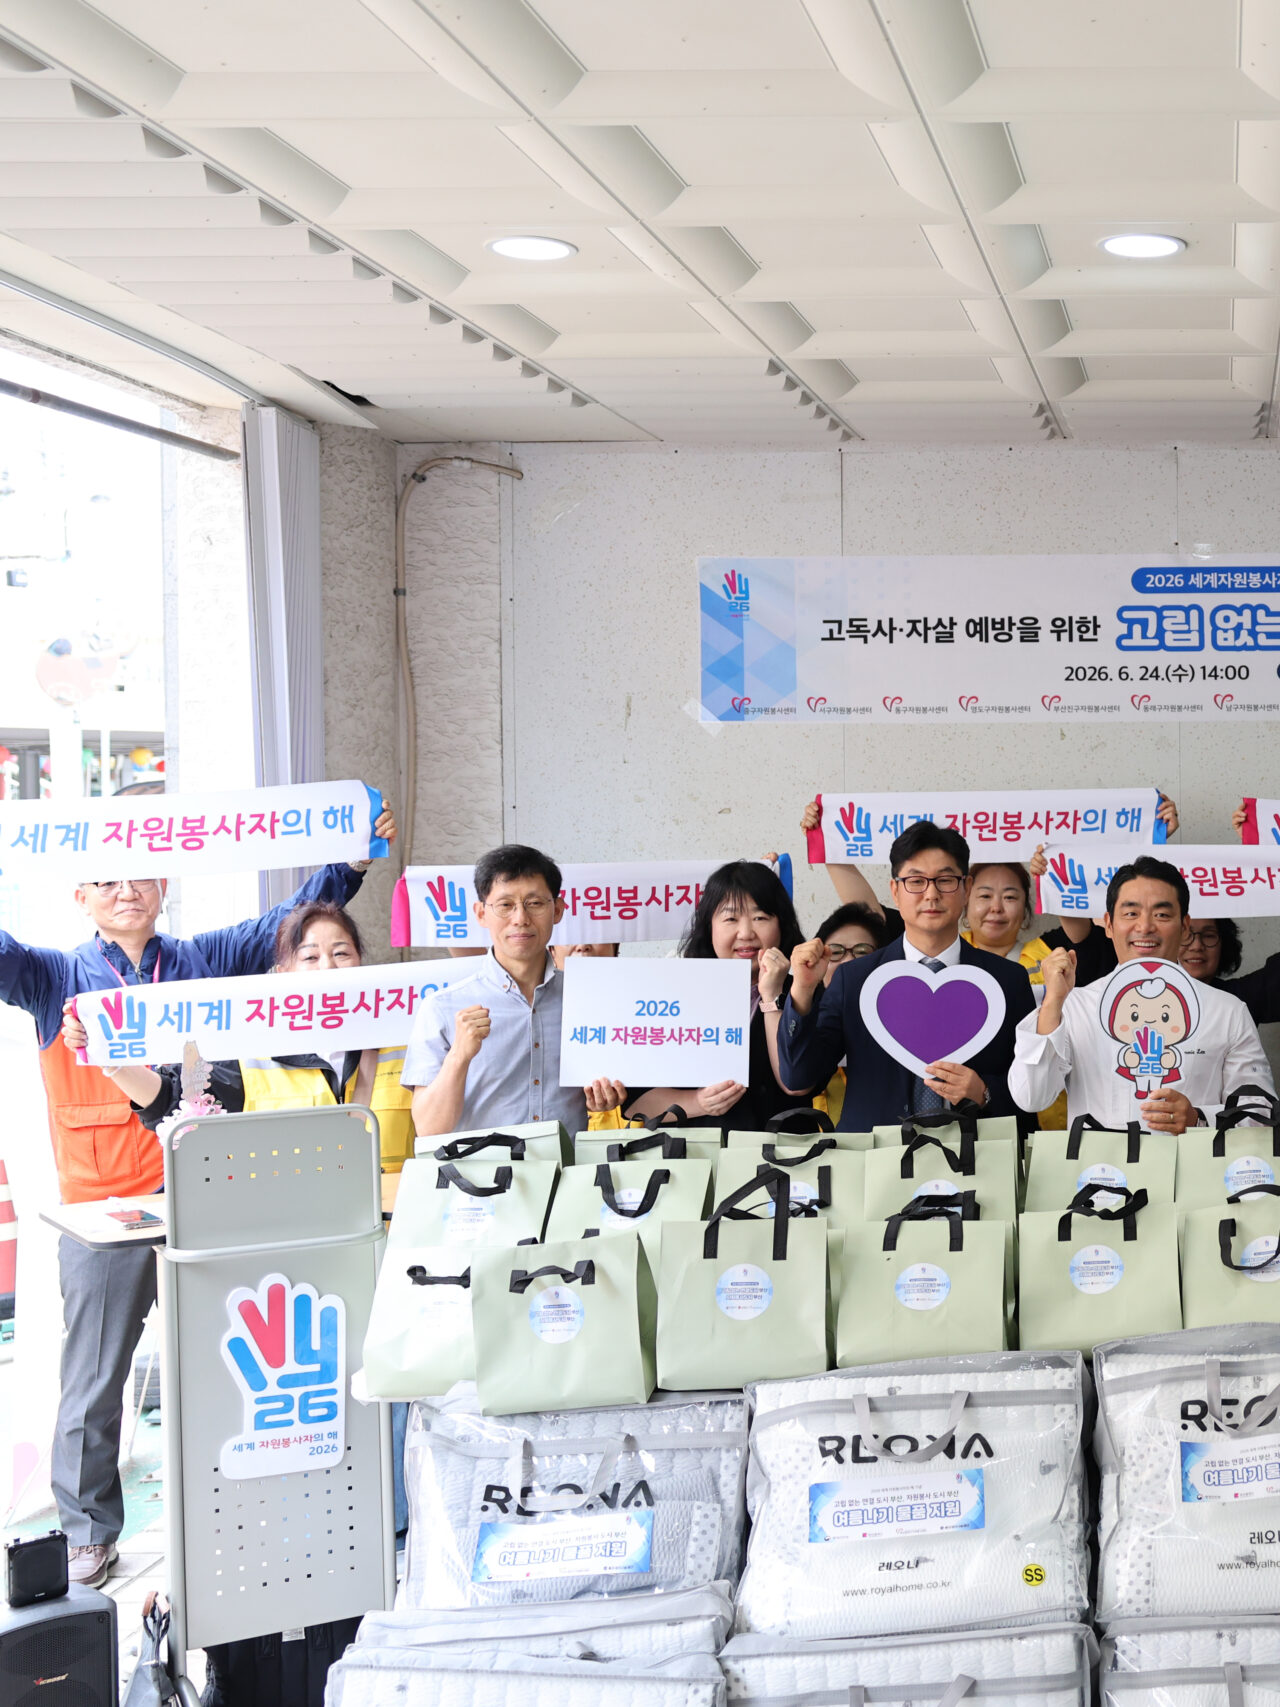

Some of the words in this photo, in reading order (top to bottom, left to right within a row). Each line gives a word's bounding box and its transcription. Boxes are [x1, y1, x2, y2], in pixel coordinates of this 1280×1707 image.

[1145, 574, 1184, 588] 2026
[820, 616, 957, 644] 고독사·자살
[965, 616, 1042, 643] 예방을
[1050, 615, 1101, 643] 위한
[1116, 604, 1205, 652] 고립
[1064, 666, 1113, 682] 2026.
[1118, 666, 1134, 682] 6.
[1138, 663, 1195, 683] 24.(수)
[1200, 664, 1250, 681] 14:00
[10, 821, 90, 854] 세계
[102, 808, 312, 853] 자원봉사자의
[322, 804, 355, 834] 해
[1115, 806, 1143, 834] 해
[846, 843, 874, 858] 26
[1061, 894, 1090, 910] 26
[436, 922, 468, 938] 26
[156, 998, 232, 1034] 세계
[634, 1000, 680, 1016] 2026
[570, 1026, 606, 1045] 세계
[611, 1026, 720, 1046] 자원봉사자의
[724, 1027, 743, 1046] 해
[108, 1042, 147, 1059] 26
[1139, 1062, 1162, 1074] 26
[254, 1388, 338, 1431] 26
[232, 1442, 255, 1452] 세계
[259, 1433, 324, 1450] 자원봉사자의
[327, 1430, 338, 1440] 해
[308, 1444, 338, 1456] 2026
[1204, 1466, 1263, 1486] 여름나기
[832, 1506, 894, 1528] 여름나기
[896, 1502, 928, 1522] 물품
[929, 1500, 962, 1518] 지원
[1024, 1567, 1044, 1582] SS
